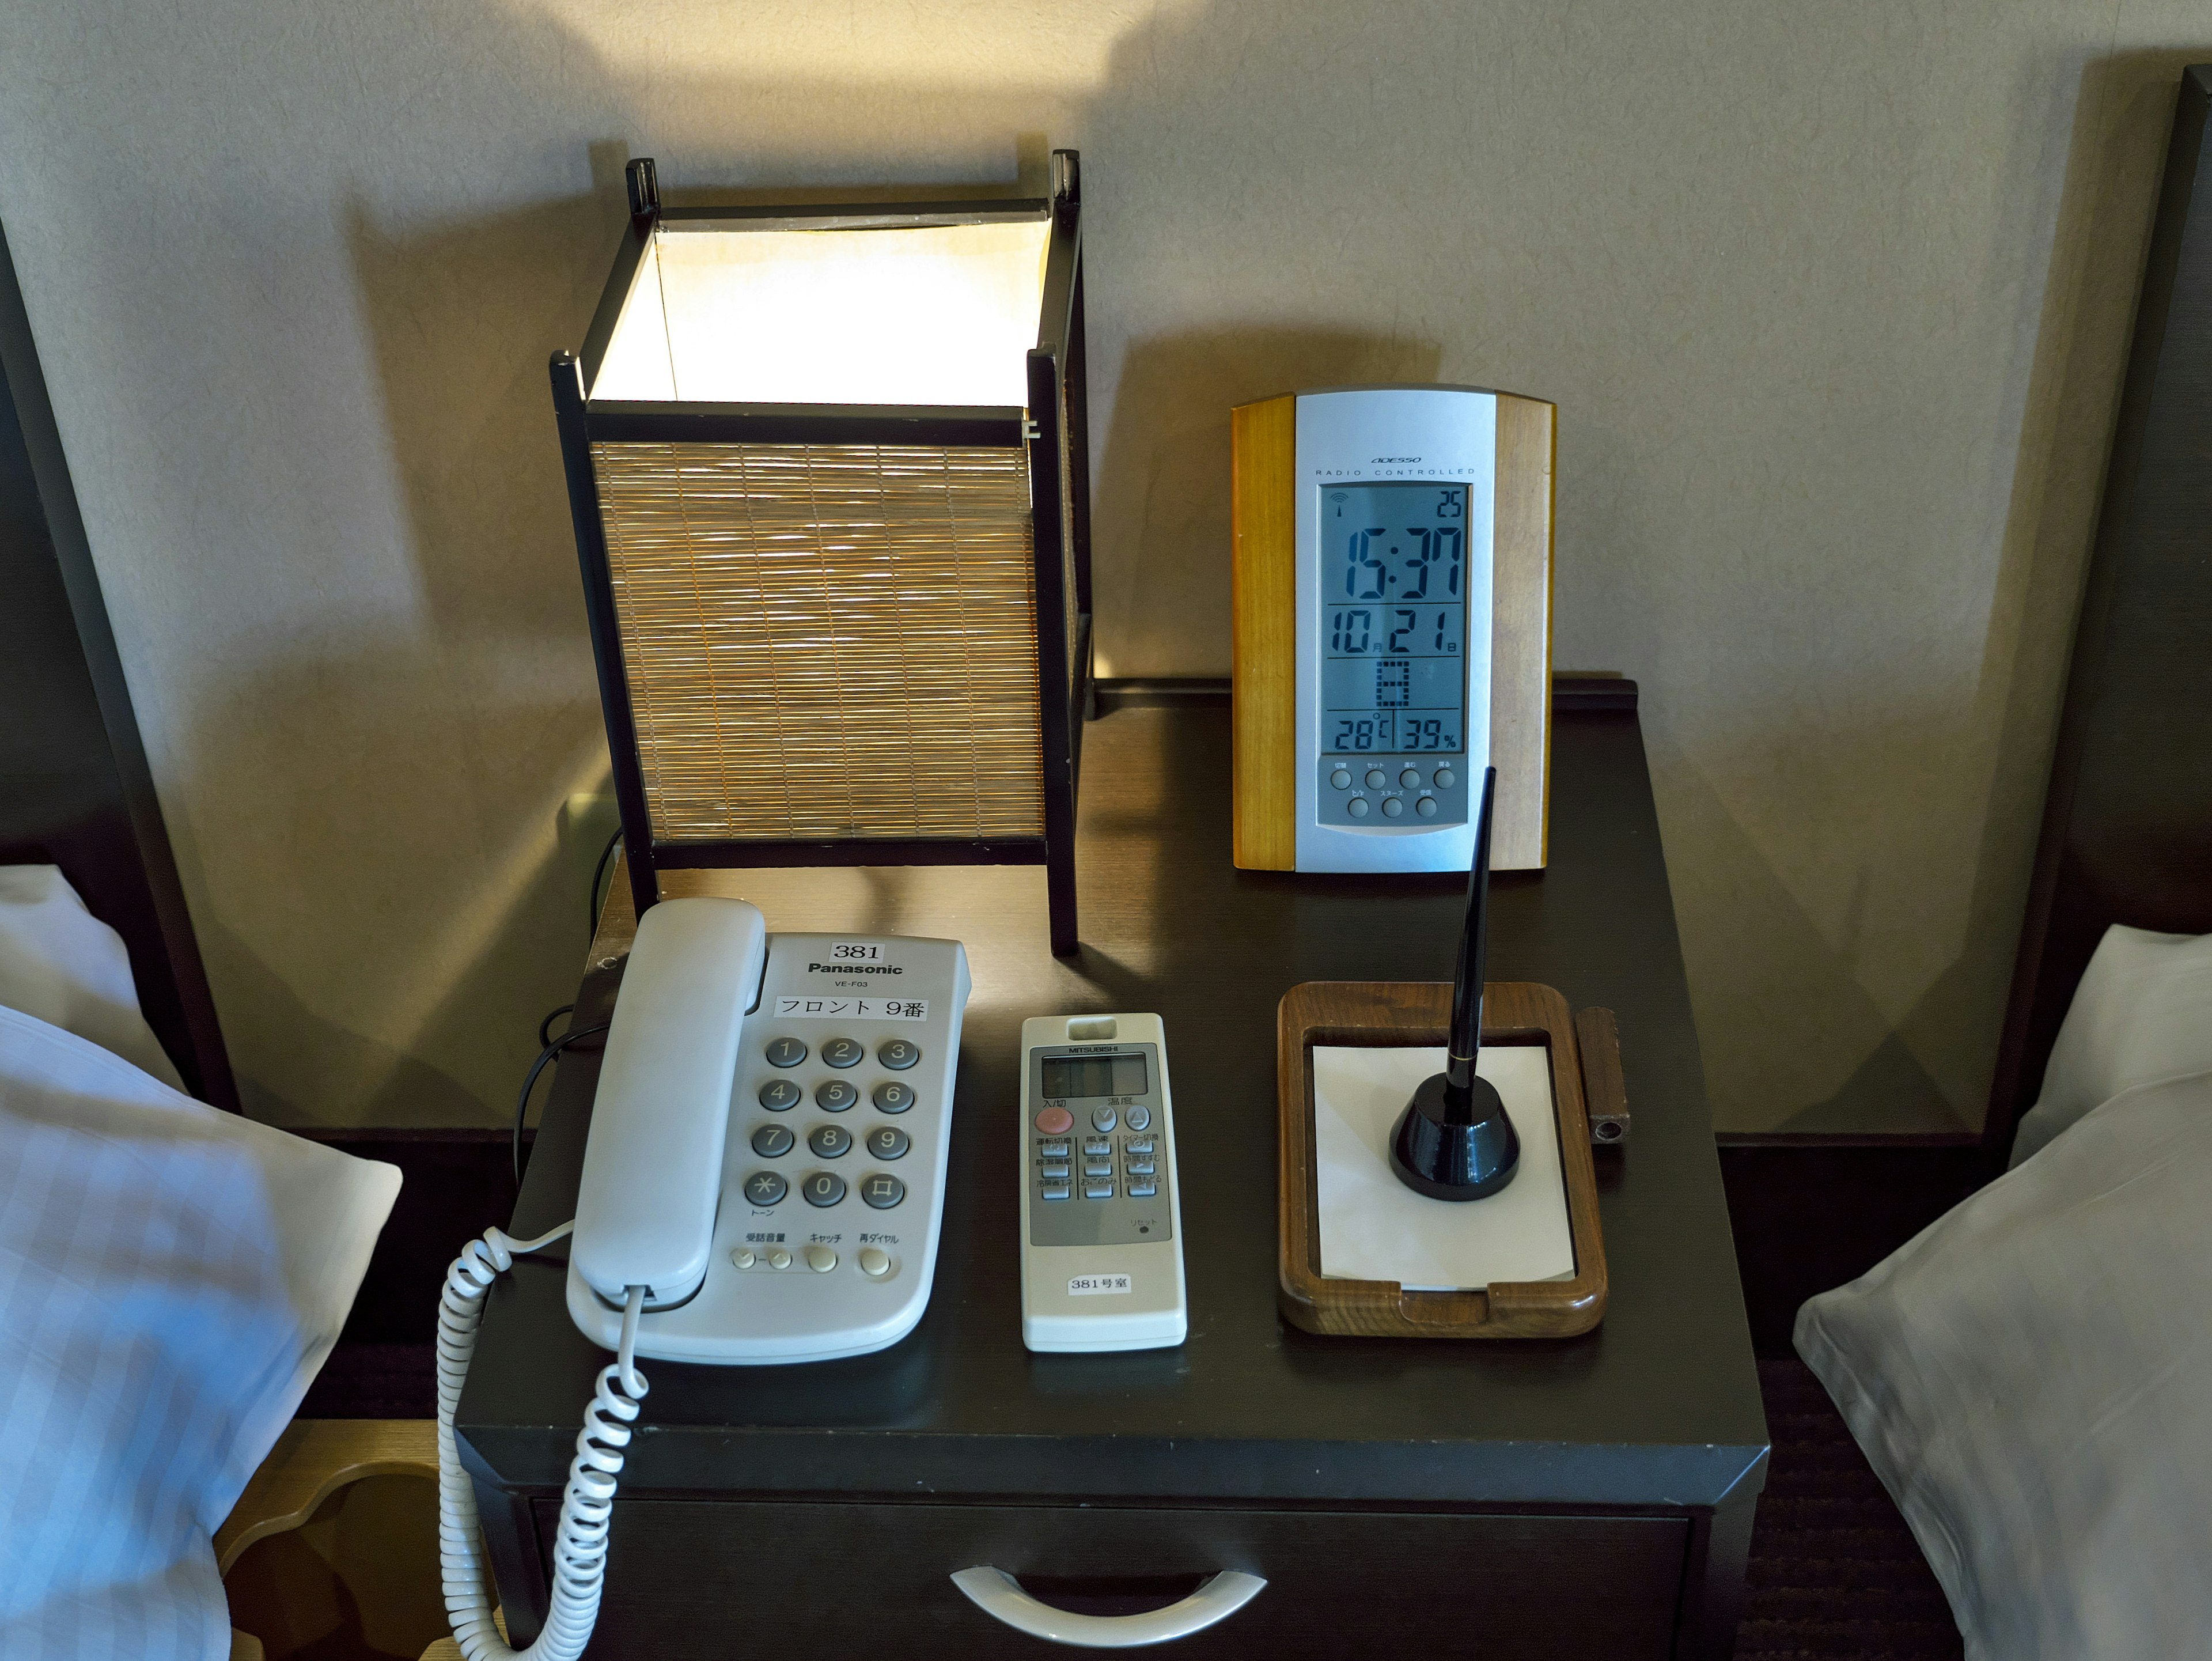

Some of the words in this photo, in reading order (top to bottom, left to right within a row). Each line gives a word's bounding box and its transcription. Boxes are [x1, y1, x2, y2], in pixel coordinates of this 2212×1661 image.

[1437, 491, 1461, 518] 25
[1346, 527, 1461, 600] 15:37
[834, 945, 879, 959] 381
[808, 963, 903, 975] Panasonic
[782, 1000, 870, 1015] フロント
[886, 1001, 925, 1018] 9番
[781, 1042, 790, 1057] 1
[835, 1042, 850, 1057] 2
[891, 1044, 906, 1058] 3
[1069, 1046, 1118, 1054] MITSUBISHI
[771, 1084, 785, 1100] 4
[828, 1084, 843, 1100] 5
[886, 1086, 900, 1102] 6
[1043, 1099, 1066, 1108] 入/切
[1107, 1097, 1133, 1106] 温度
[766, 1129, 781, 1145] 7
[822, 1130, 837, 1146] 8
[881, 1132, 896, 1148] 9
[1124, 1154, 1160, 1162] 時間すすむ
[816, 1177, 831, 1194] 0
[746, 1233, 786, 1243] 受話音量
[810, 1234, 842, 1243] キャッチ
[859, 1233, 899, 1243] 再ダイヤル
[1071, 1278, 1127, 1289] 381号室
